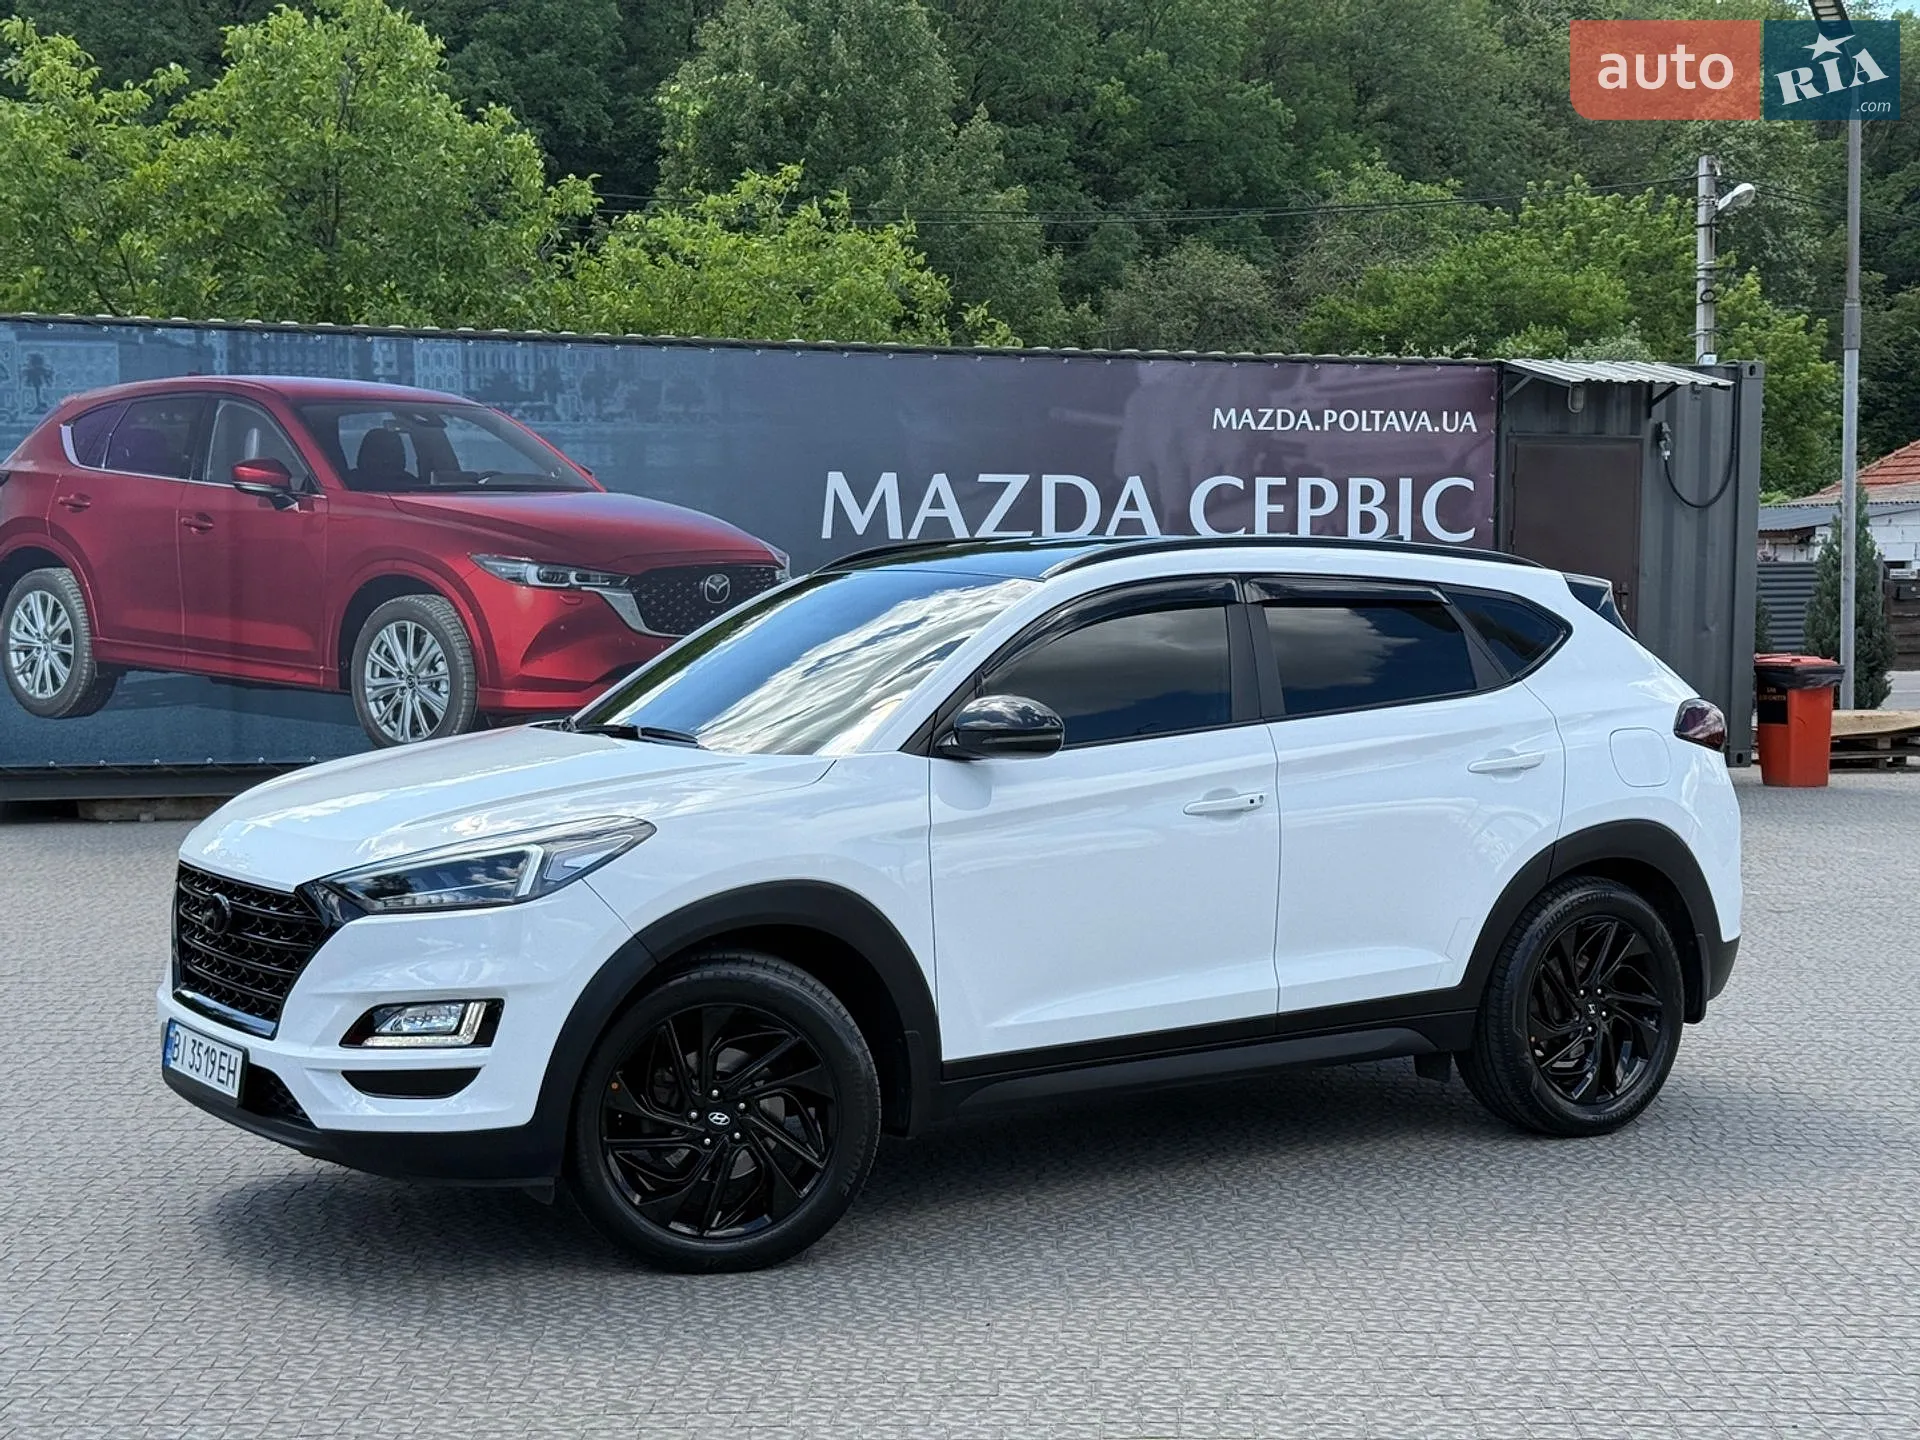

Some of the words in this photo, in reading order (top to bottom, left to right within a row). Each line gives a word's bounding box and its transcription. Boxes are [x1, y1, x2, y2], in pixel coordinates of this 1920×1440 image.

[1212, 407, 1478, 433] MAZDA.POLTAVA.UA
[821, 471, 1161, 540] MAZDA
[1189, 475, 1476, 542] СЕРВІС
